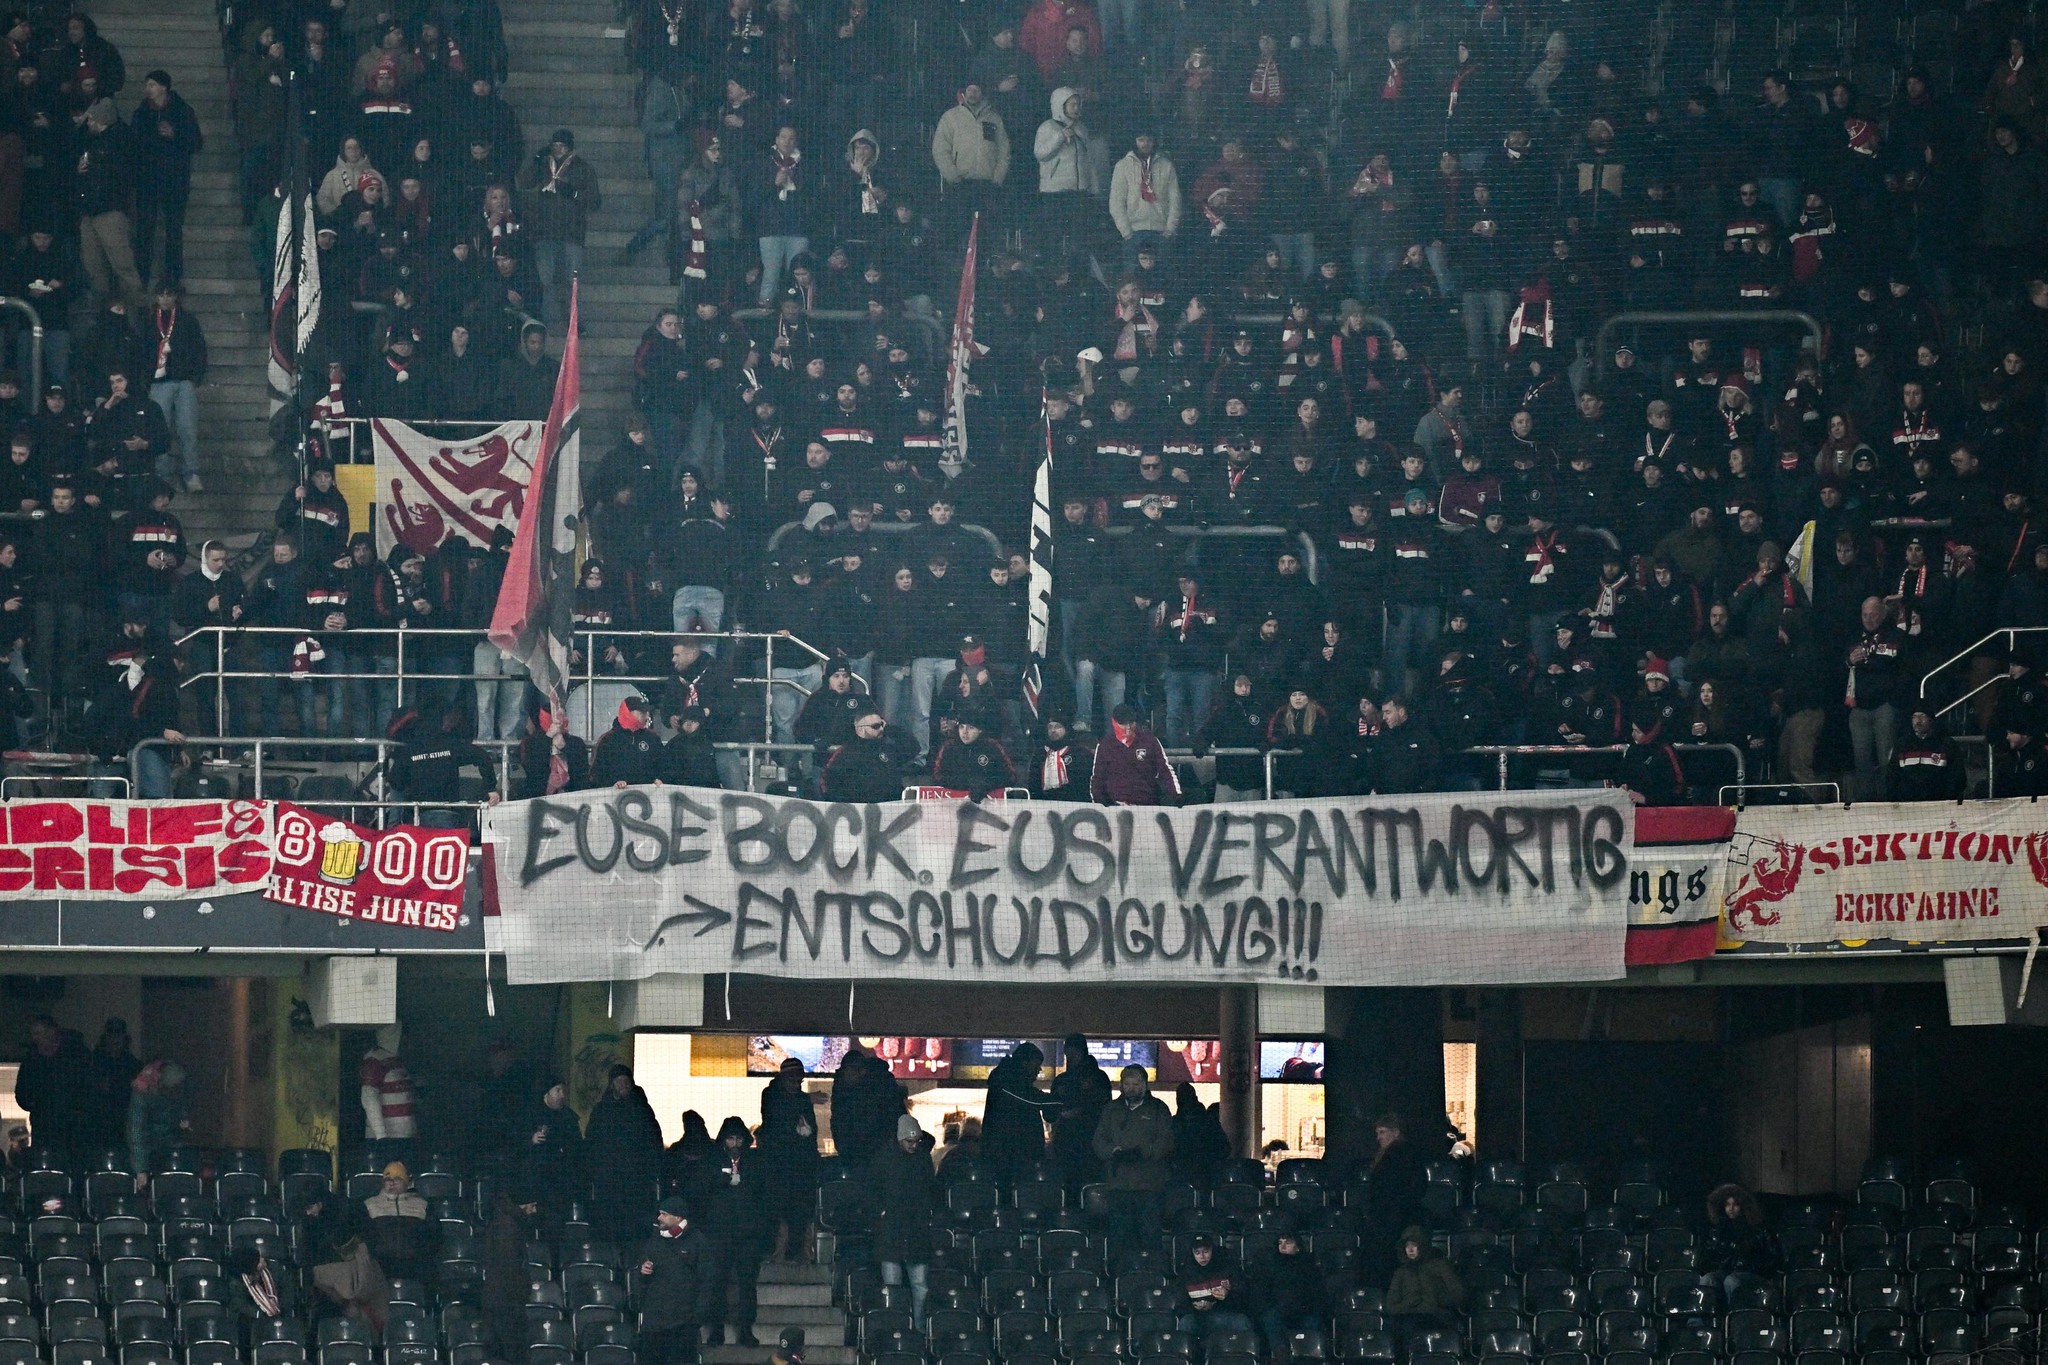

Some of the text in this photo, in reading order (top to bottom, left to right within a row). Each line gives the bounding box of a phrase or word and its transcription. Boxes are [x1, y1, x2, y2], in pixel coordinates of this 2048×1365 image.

[950, 799, 1135, 896] EUSI
[1155, 803, 1628, 902] VERANTWORTIG
[1809, 830, 2023, 875] SEKTION
[263, 873, 458, 930] ALTISE JUNGS
[1836, 887, 1999, 922] ECKFAHNE
[731, 882, 1323, 981] ENTSCHULDIGUNG!!!
